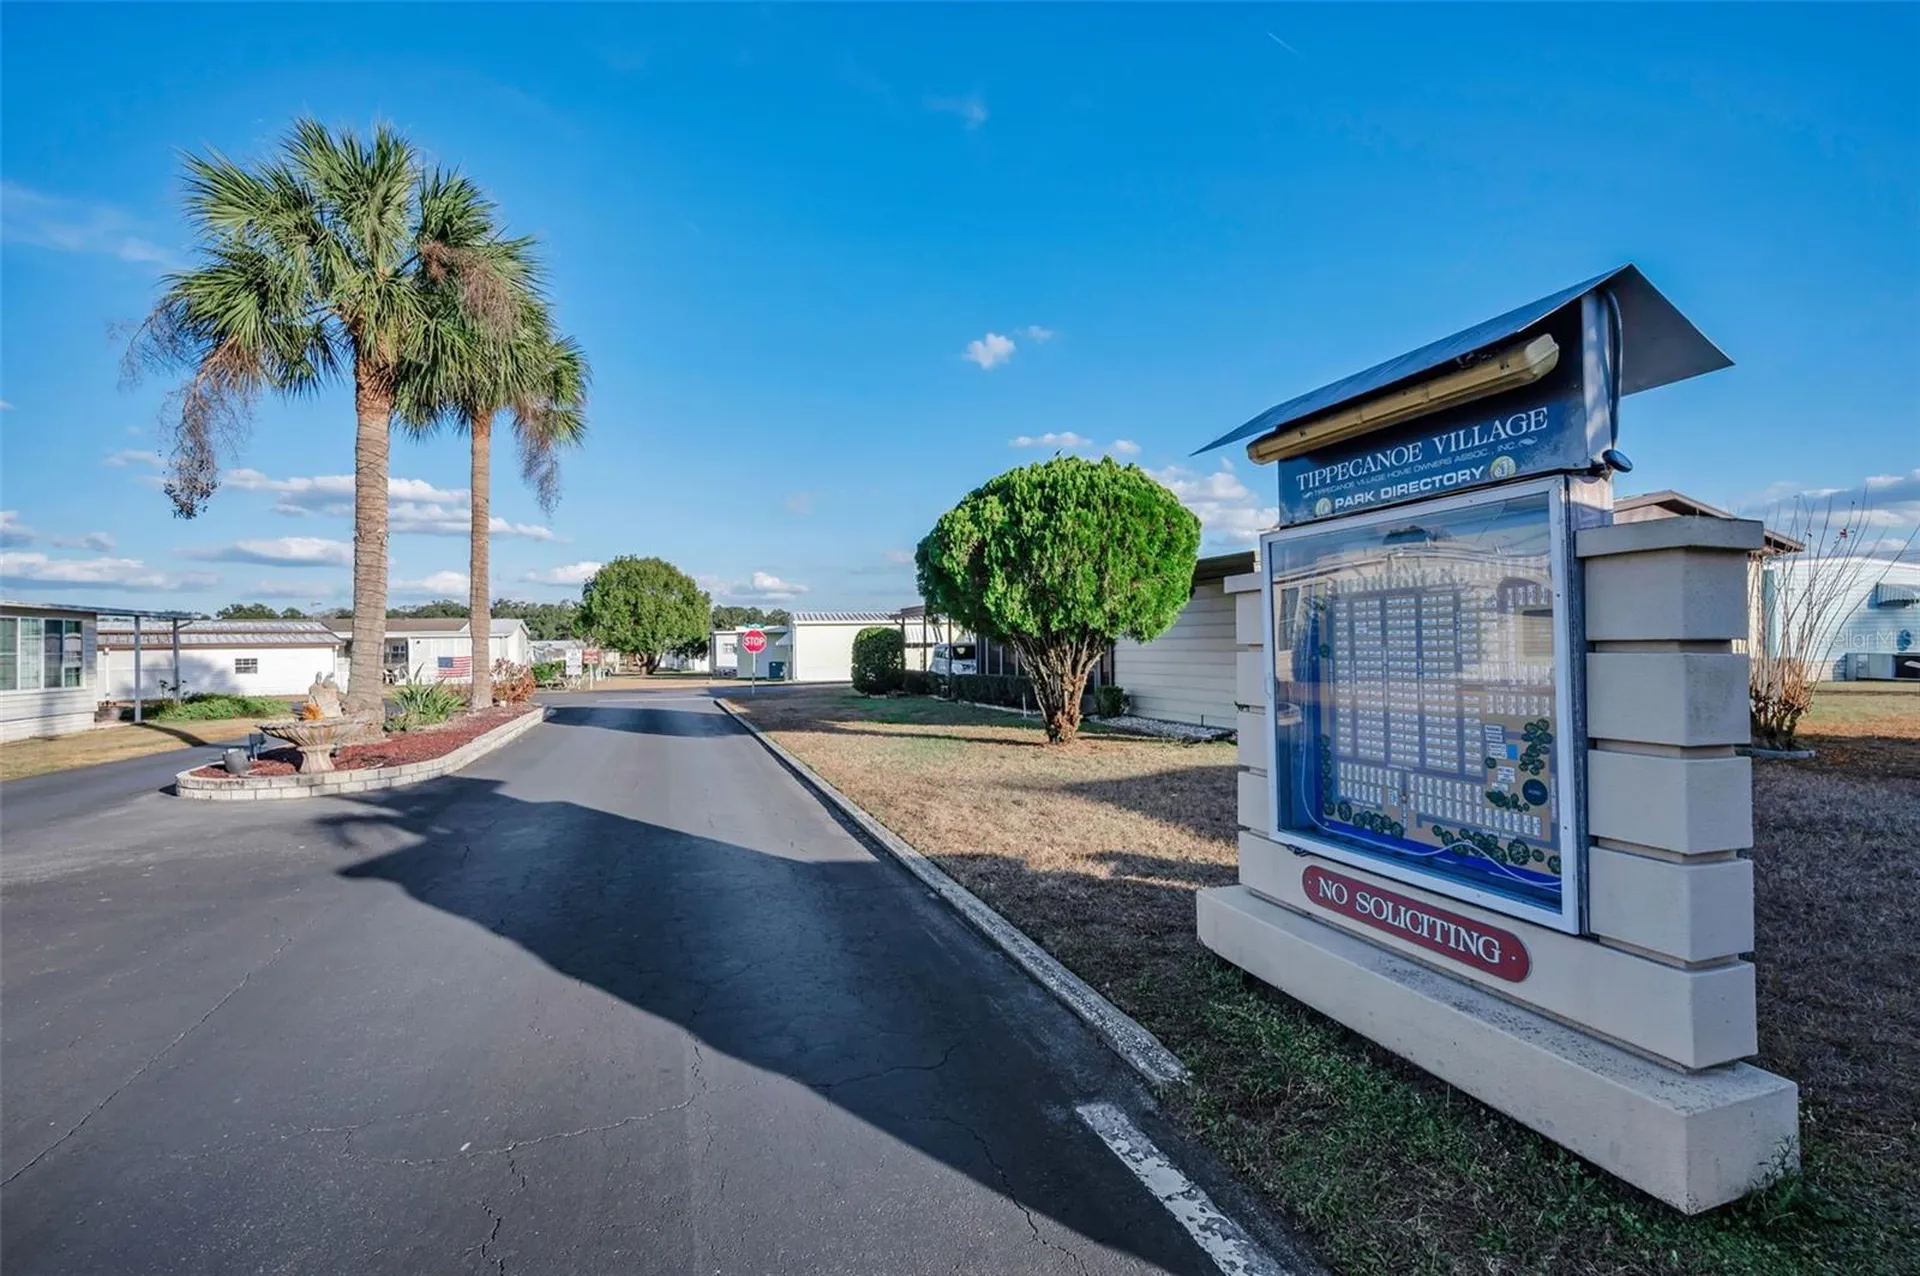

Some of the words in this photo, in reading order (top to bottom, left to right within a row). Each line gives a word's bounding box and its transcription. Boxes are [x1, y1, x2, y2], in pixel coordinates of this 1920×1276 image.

[1296, 442, 1423, 491] TIPPECANOE
[1432, 407, 1548, 455] VILLAGE
[1334, 489, 1376, 509] PARK
[1380, 465, 1485, 500] DIRECTORY
[1386, 466, 1413, 479] HOME
[744, 636, 765, 647] STOP
[1318, 876, 1348, 905] NO
[1355, 891, 1501, 964] SOLICITING
